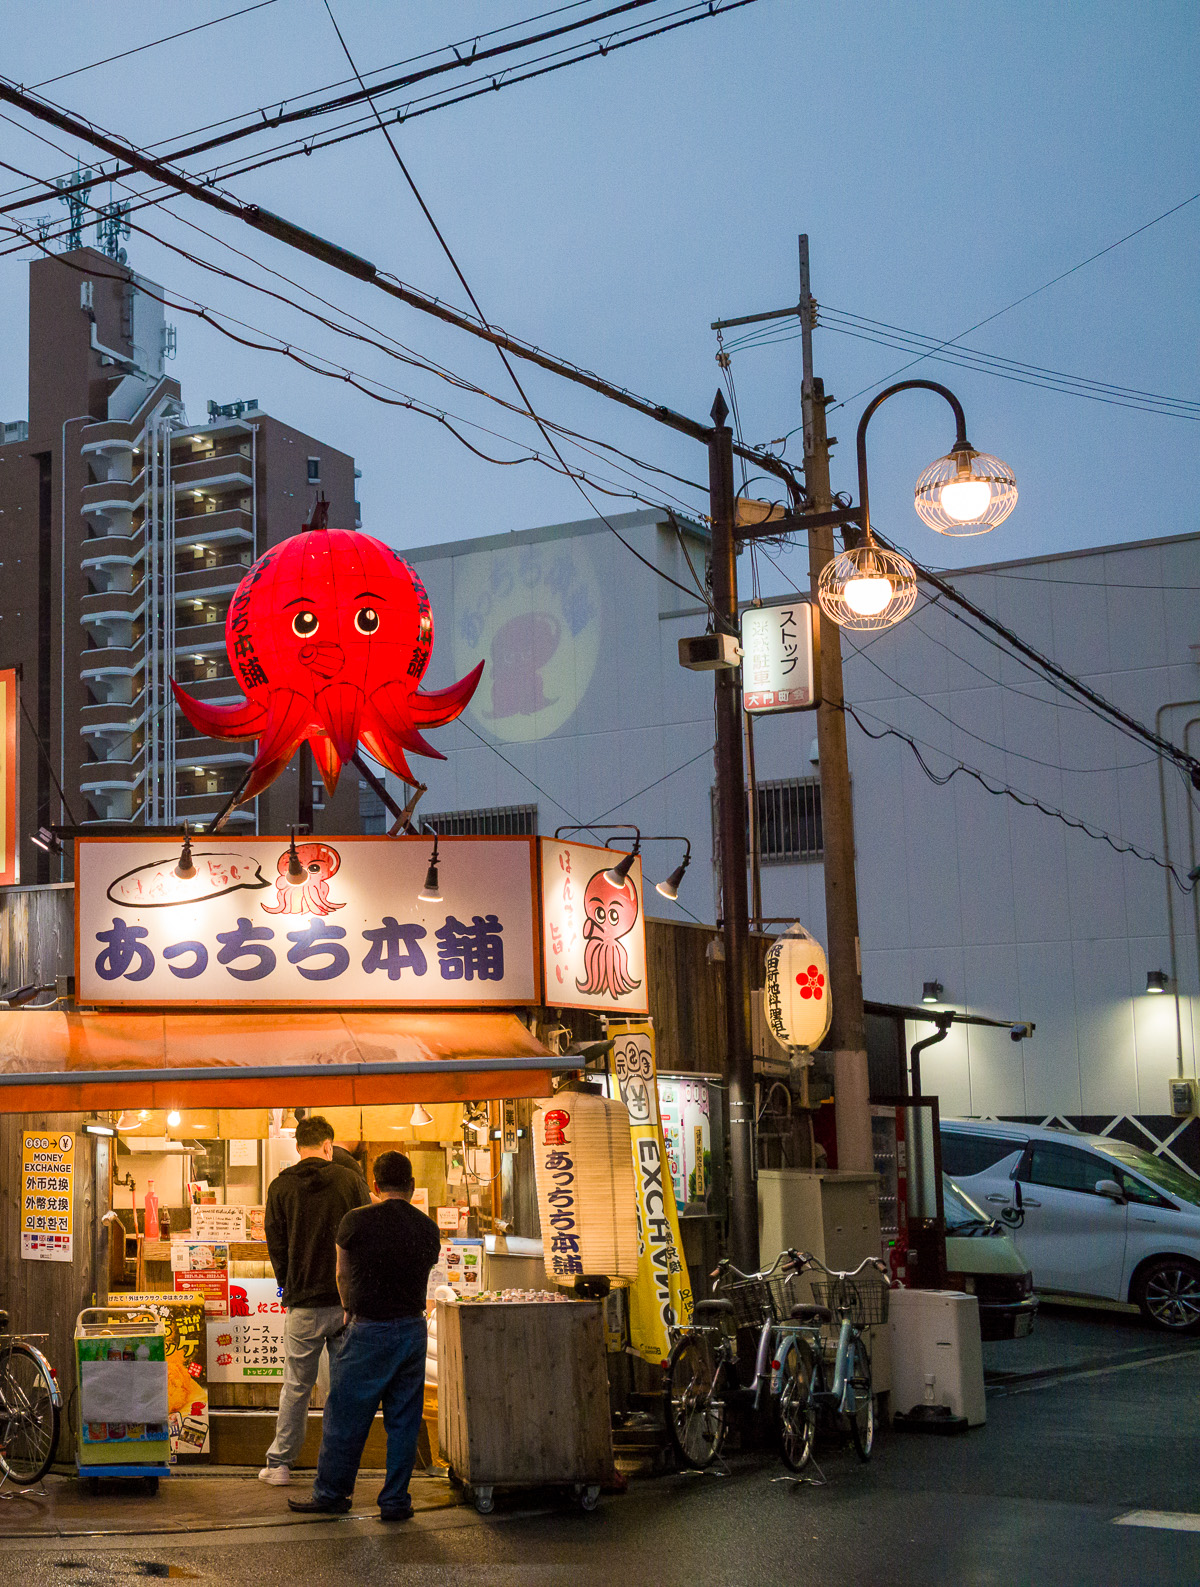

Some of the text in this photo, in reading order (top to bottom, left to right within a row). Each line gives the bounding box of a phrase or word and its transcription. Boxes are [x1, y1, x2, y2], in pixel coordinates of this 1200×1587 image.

[780, 611, 798, 675] ストップ
[95, 916, 505, 982] あっちち本舗
[550, 923, 568, 984] 旨い
[24, 1163, 72, 1173] EXCHANGE
[33, 1153, 64, 1162] MONEY
[26, 1176, 69, 1191] 外币兑换
[26, 1216, 69, 1232] 외화환전
[545, 1150, 583, 1275] あっちち本舗
